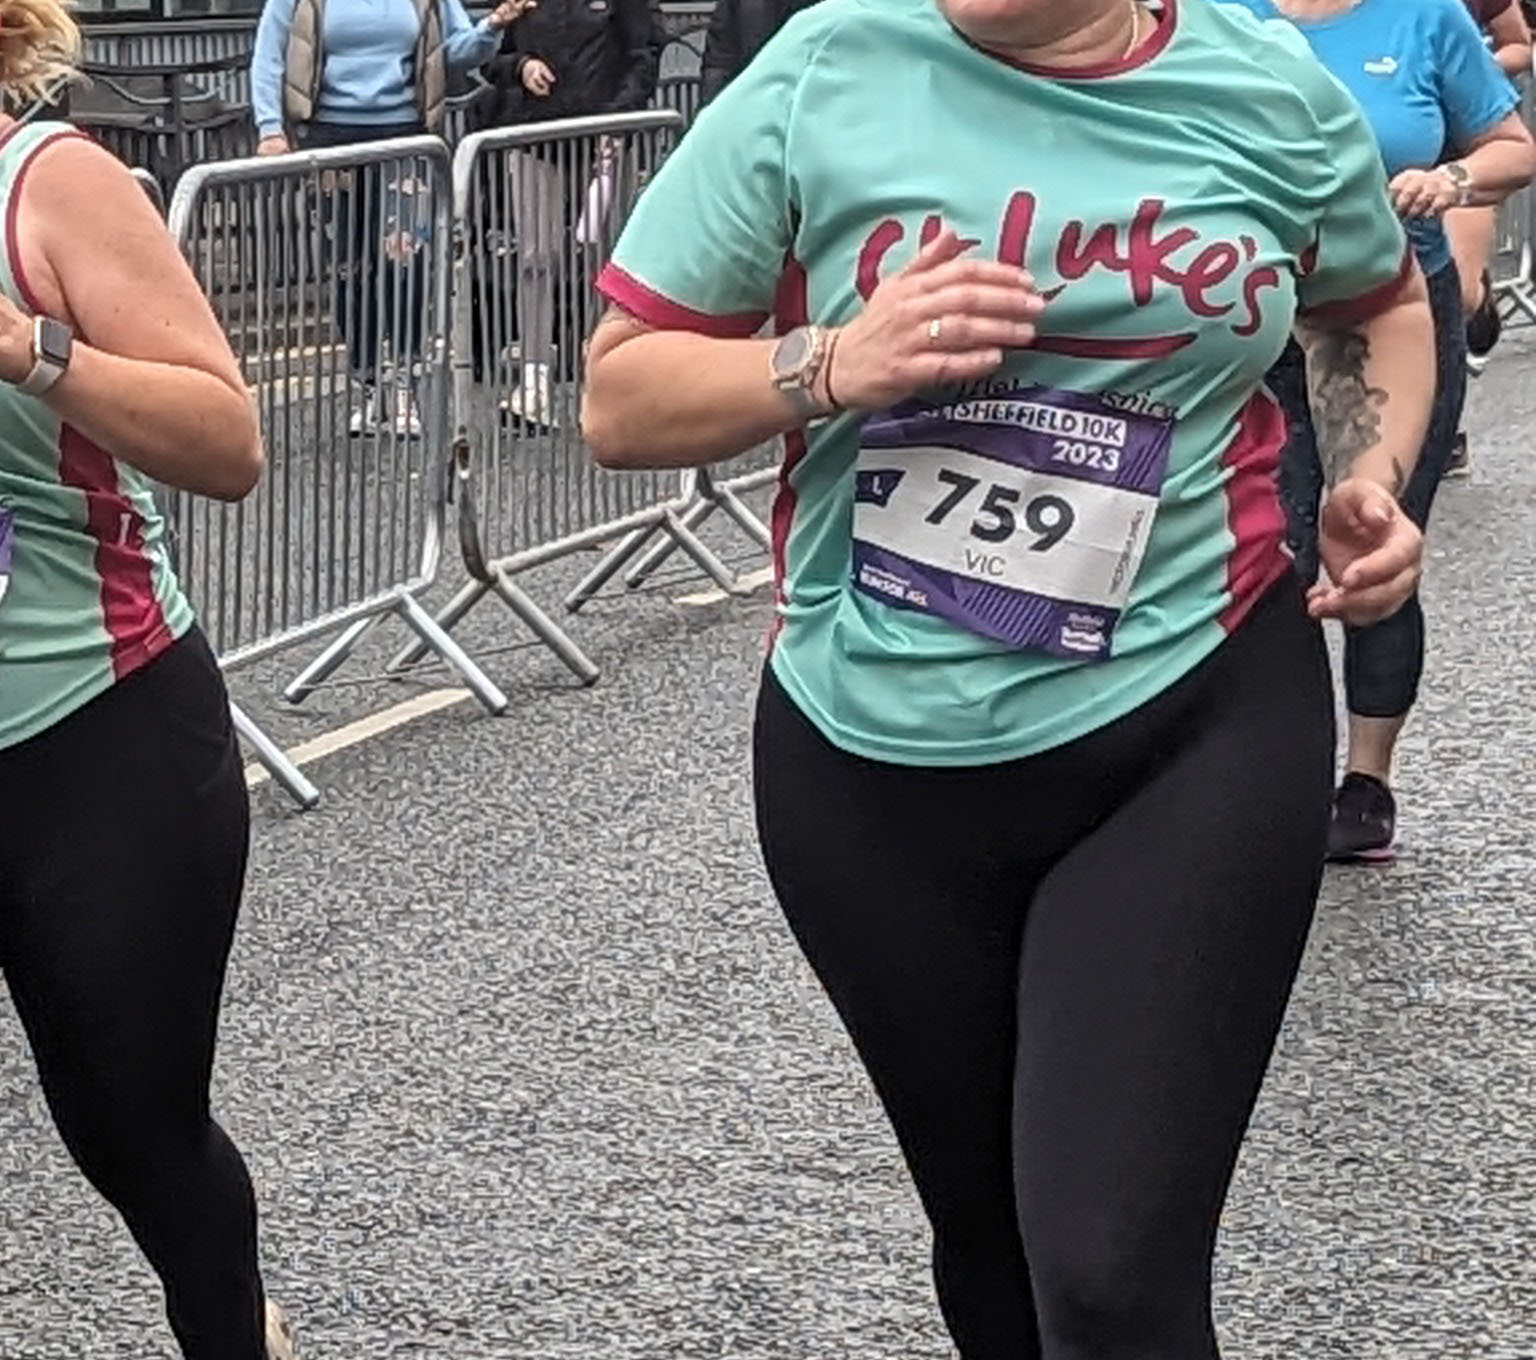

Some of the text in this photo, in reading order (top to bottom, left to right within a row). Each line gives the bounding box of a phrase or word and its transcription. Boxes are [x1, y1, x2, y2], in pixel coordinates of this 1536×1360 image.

[955, 402, 1122, 443] SHEFFIELD 10K
[1052, 441, 1121, 472] 2023
[924, 468, 1076, 552] 759
[965, 548, 1006, 577] VIC
